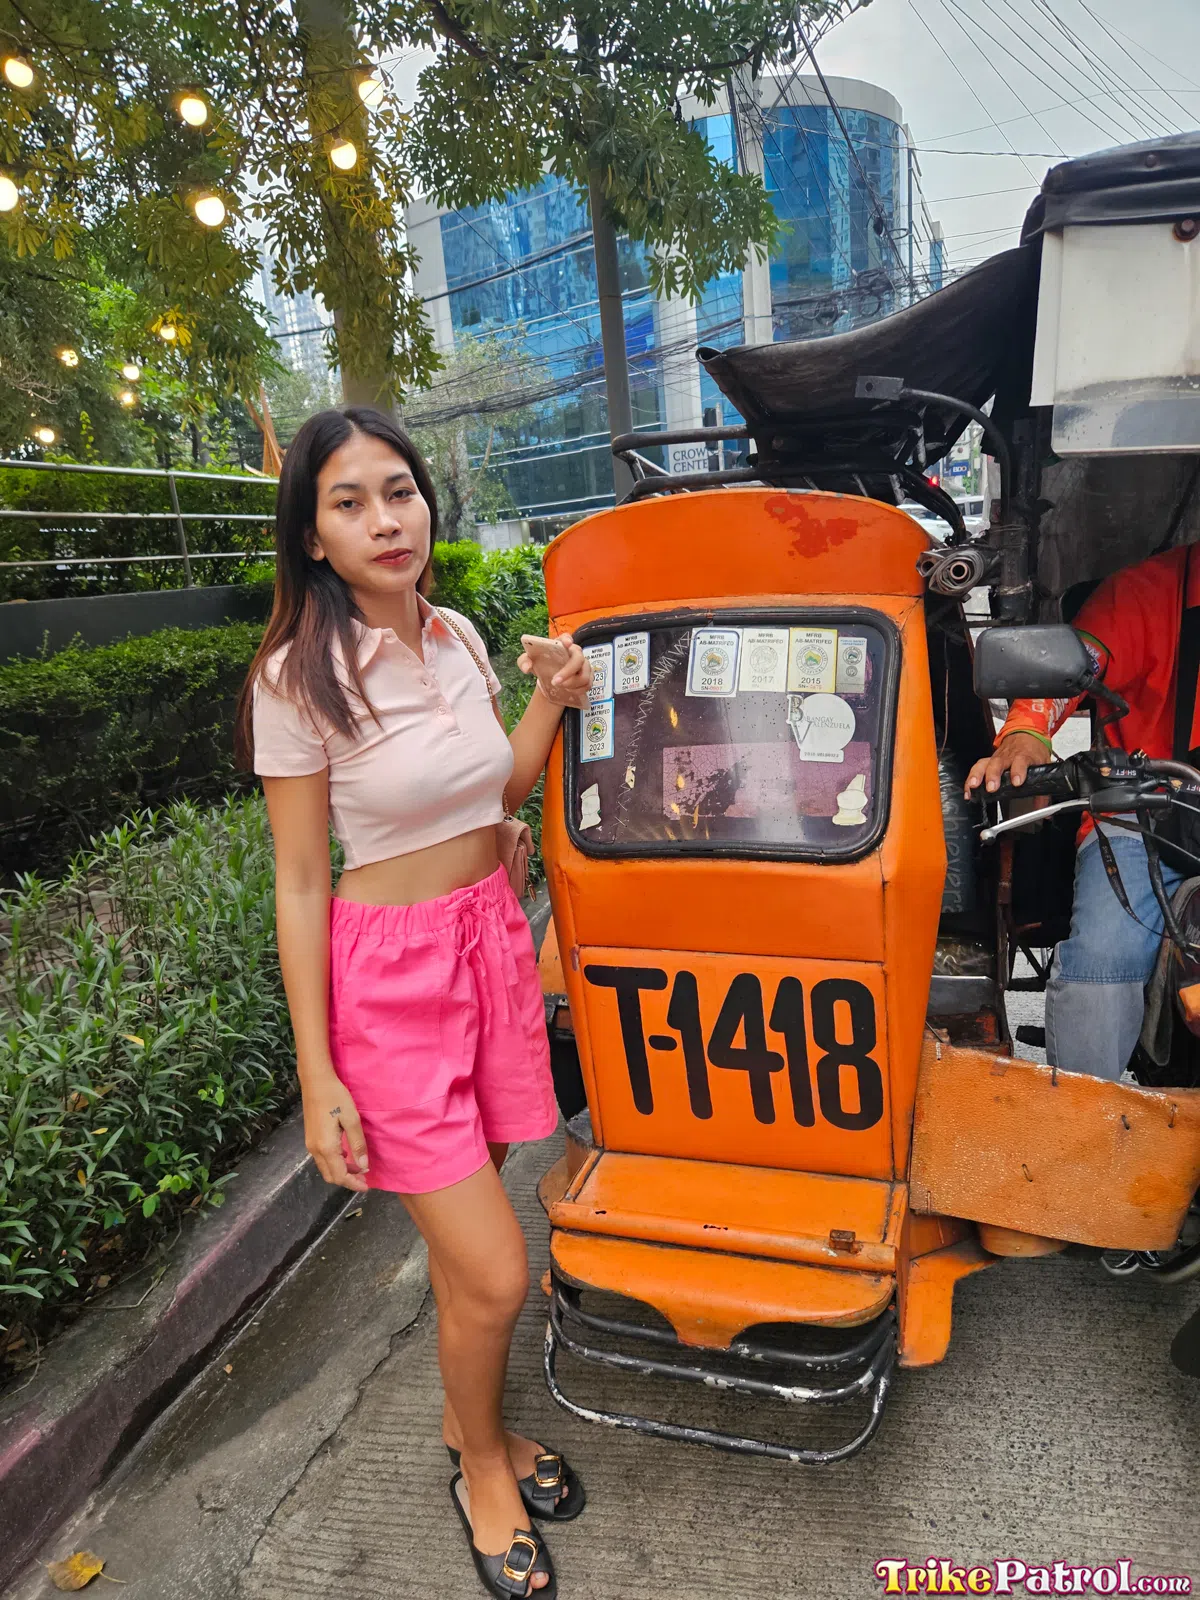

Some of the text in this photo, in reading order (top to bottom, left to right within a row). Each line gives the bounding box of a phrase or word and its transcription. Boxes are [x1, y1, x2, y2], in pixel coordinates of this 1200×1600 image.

[673, 448, 708, 461] CROW
[673, 460, 708, 473] CENTE
[952, 465, 967, 473] BDO
[622, 675, 640, 686] 2019
[701, 677, 723, 686] 2018
[752, 675, 775, 684] 2017
[801, 677, 821, 685] 2015
[589, 743, 605, 752] 2023
[584, 964, 884, 1131] T-1418
